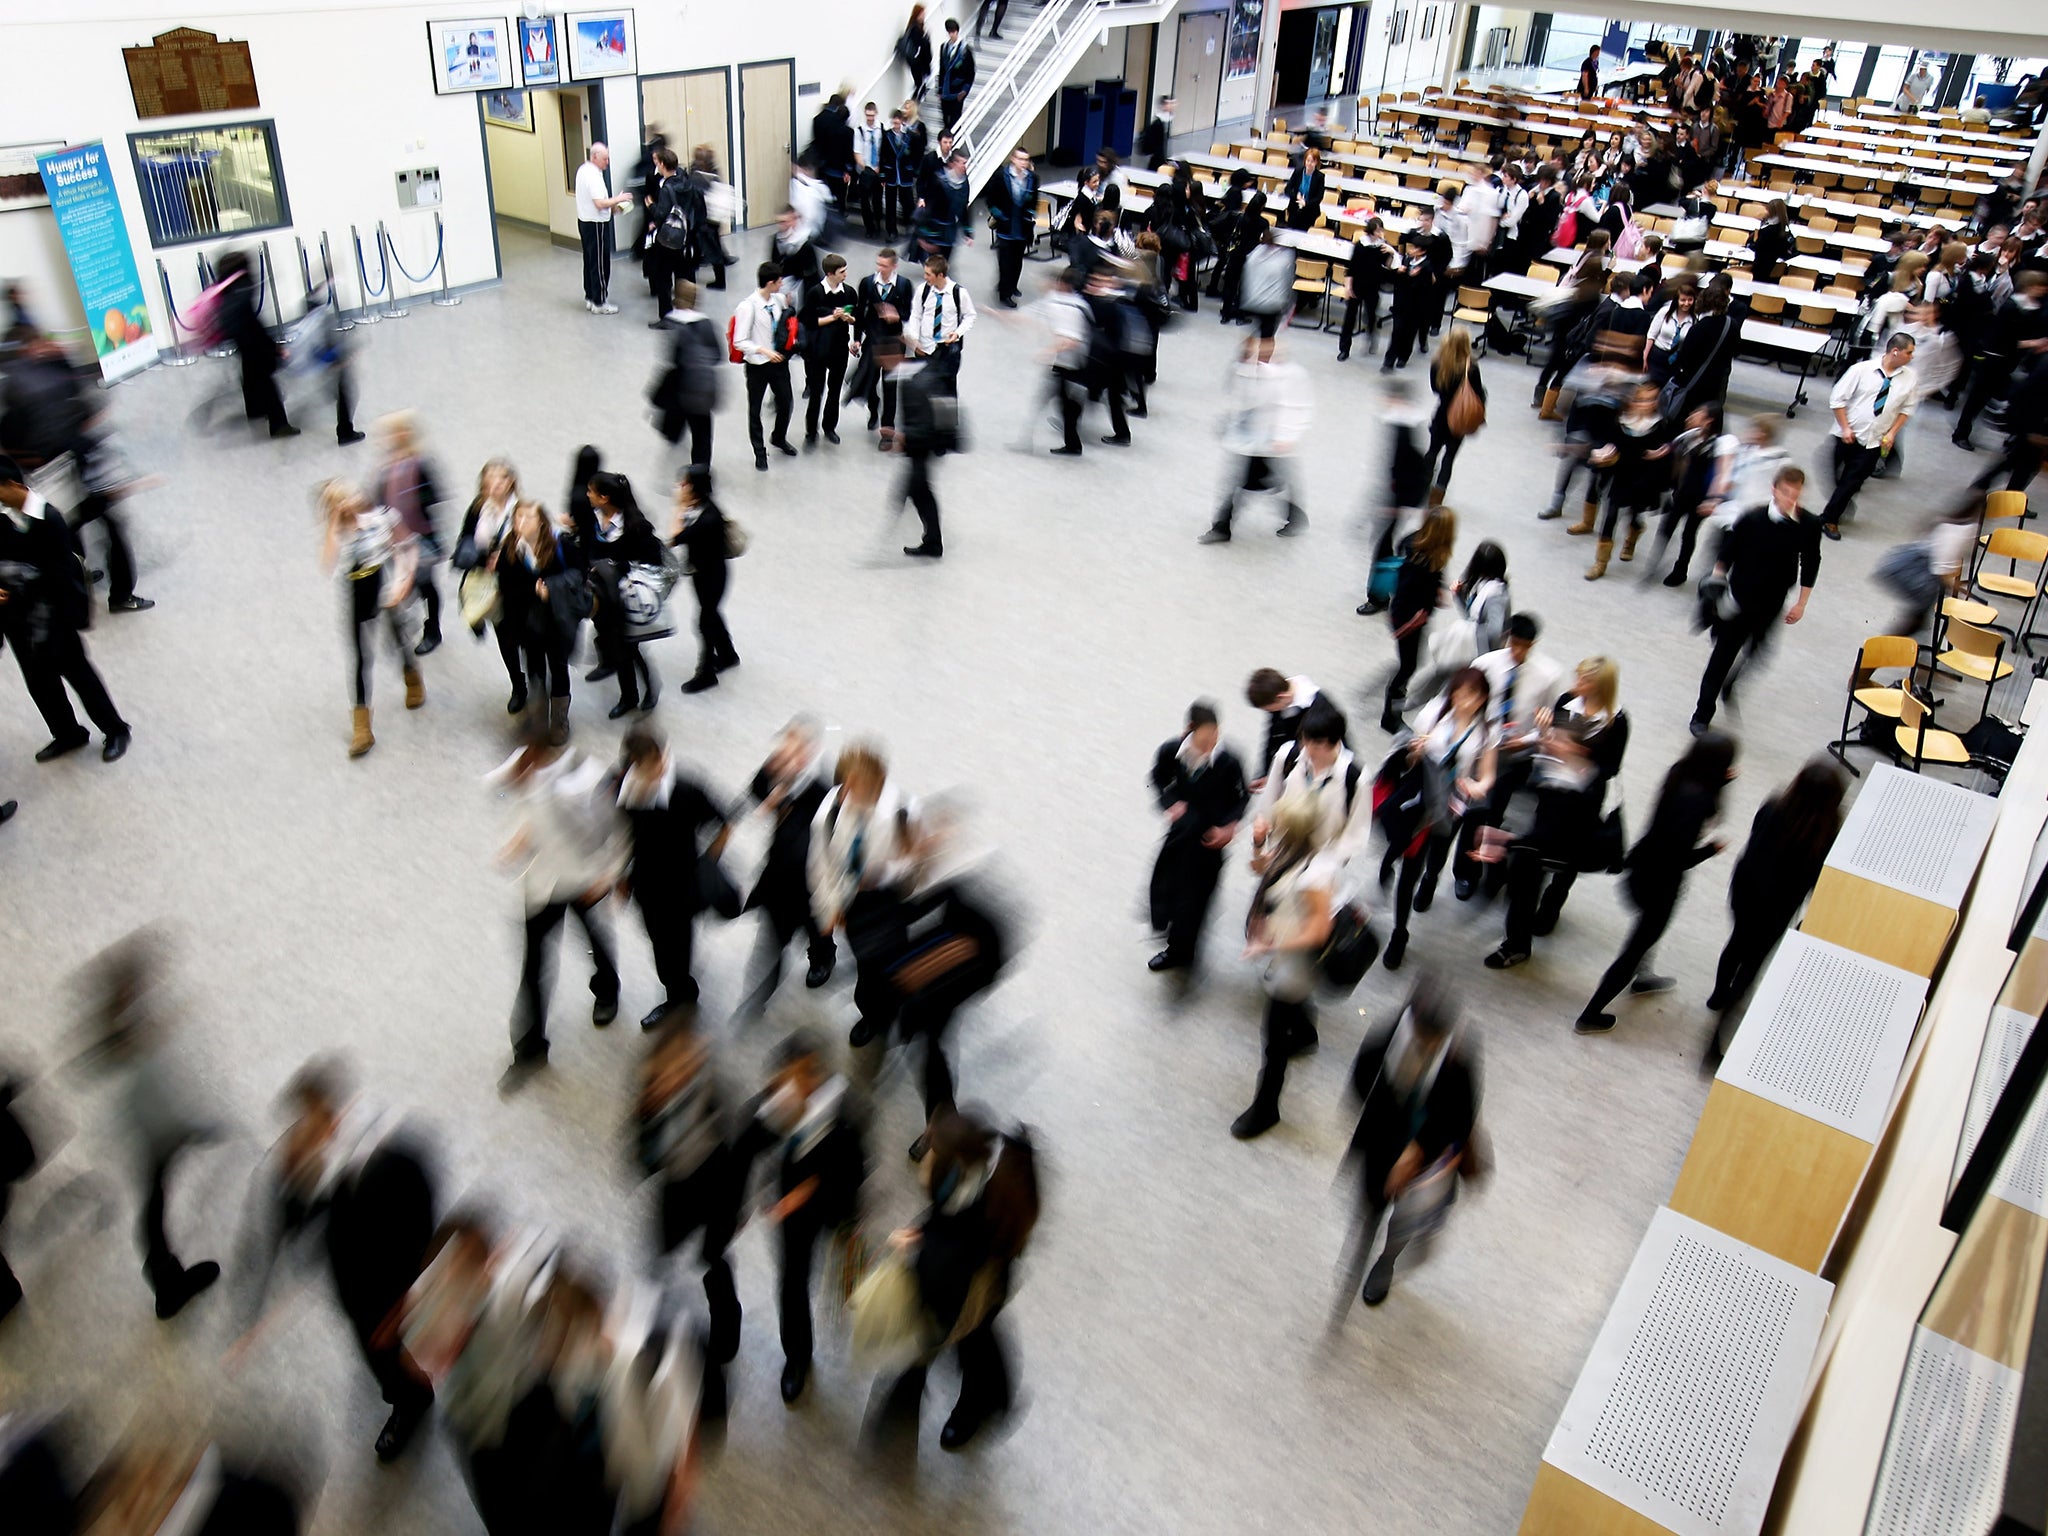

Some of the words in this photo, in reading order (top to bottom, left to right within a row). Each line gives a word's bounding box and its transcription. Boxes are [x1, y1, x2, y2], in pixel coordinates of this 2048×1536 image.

[162, 42, 181, 50] HIGH
[183, 41, 210, 49] SCHOOL
[46, 156, 83, 175] Hungry
[86, 152, 99, 165] for
[56, 166, 98, 187] Success
